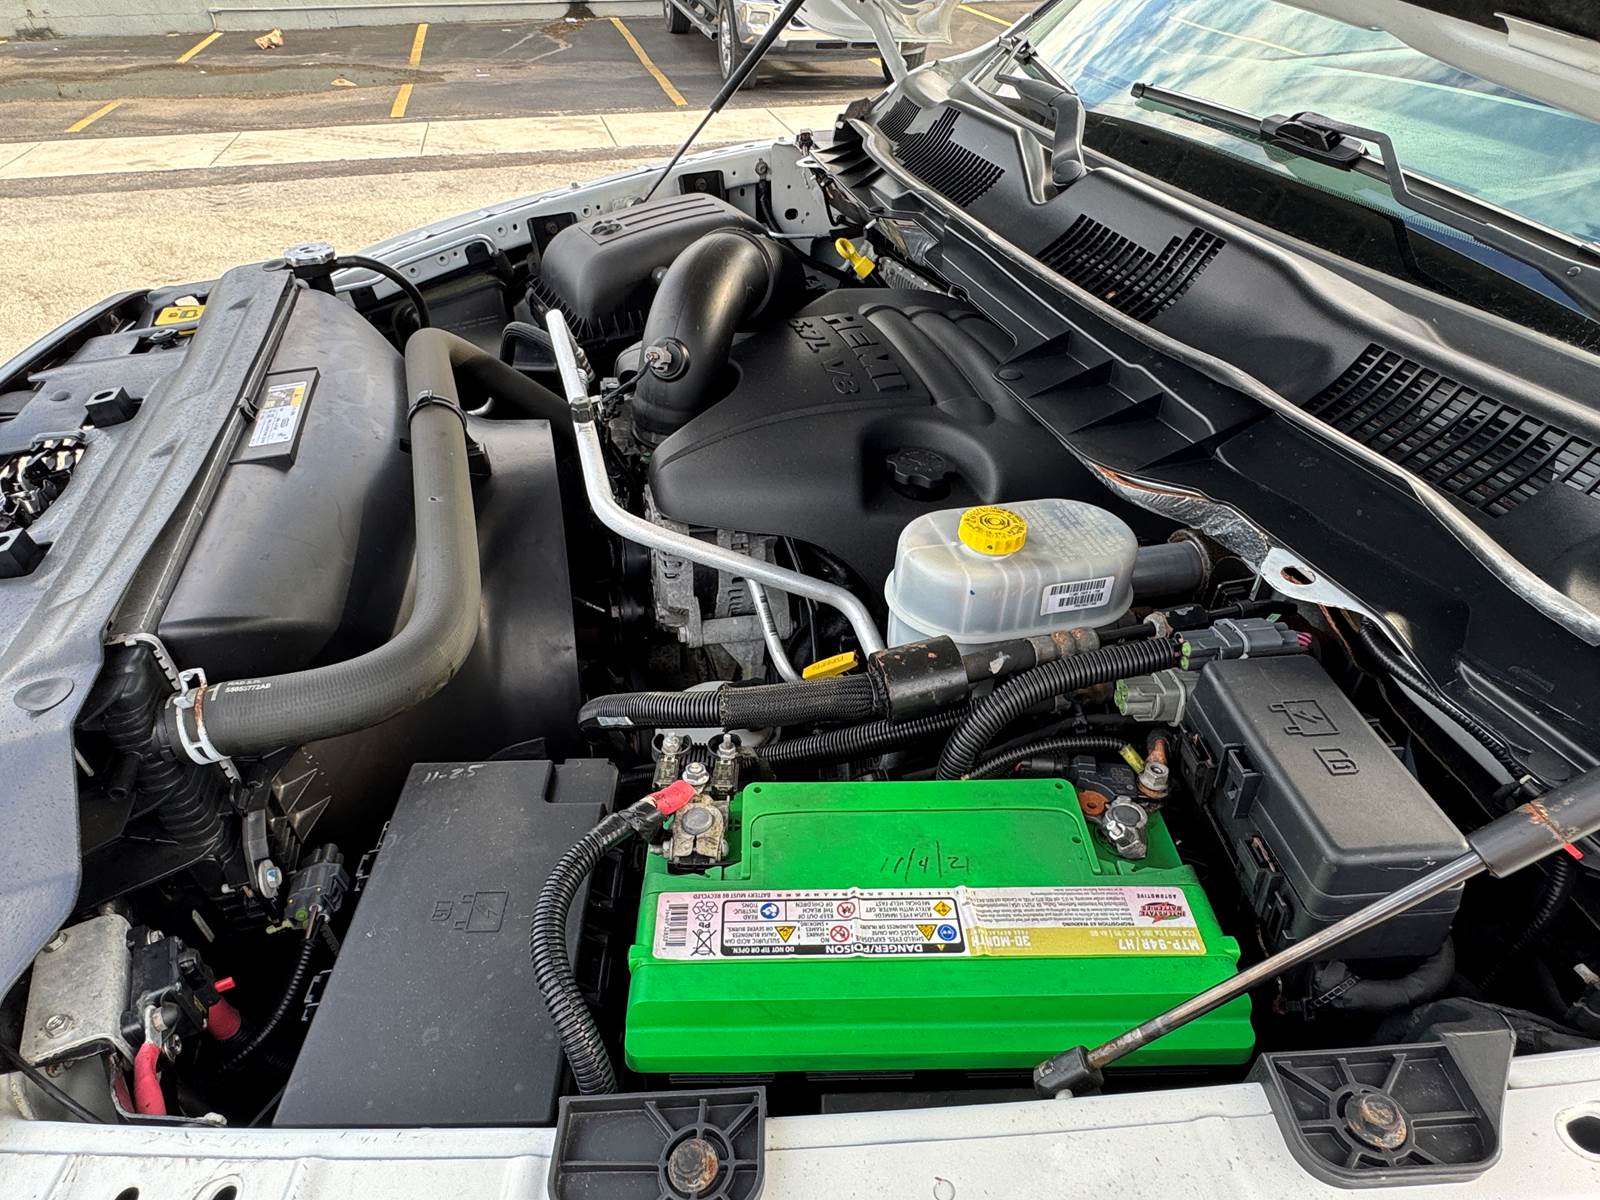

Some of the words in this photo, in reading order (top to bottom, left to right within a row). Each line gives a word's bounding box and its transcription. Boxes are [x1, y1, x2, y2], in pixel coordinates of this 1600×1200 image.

[822, 314, 910, 392] HEMI
[821, 357, 861, 394] V8
[970, 934, 1032, 946] 30-MONTH
[1119, 937, 1201, 951] MTP-94R/H7
[825, 942, 923, 954] DANGER/POISON
